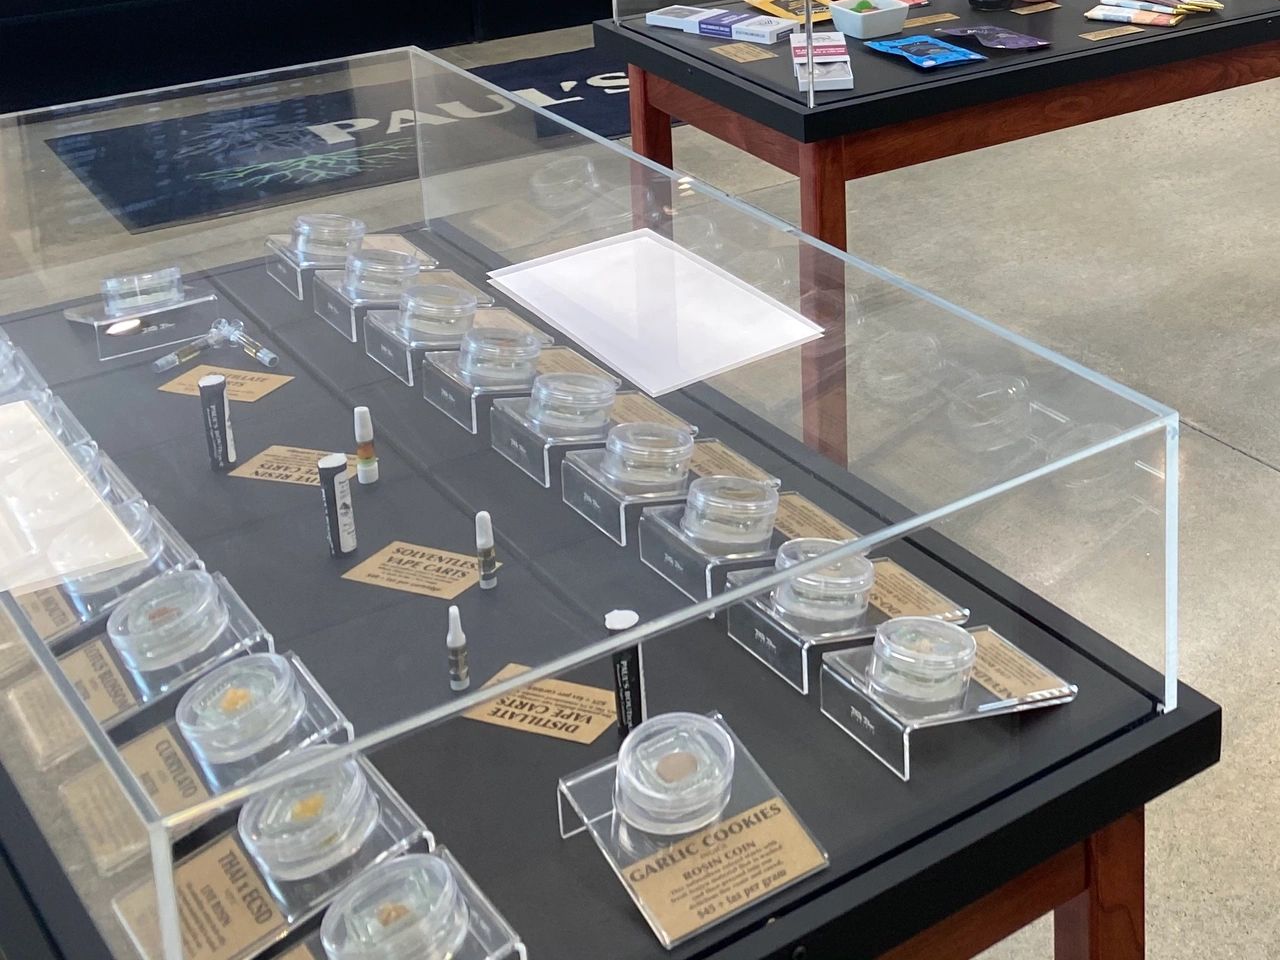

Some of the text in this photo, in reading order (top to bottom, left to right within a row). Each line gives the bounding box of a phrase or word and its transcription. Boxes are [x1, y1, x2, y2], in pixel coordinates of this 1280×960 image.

[312, 71, 631, 145] PAUL'S
[386, 555, 470, 578] VAPE CARTS
[487, 707, 580, 735] DISTILLATE
[495, 696, 594, 726] VAPE CARTS
[629, 803, 782, 885] GARLIC COOKIES
[683, 840, 756, 880] ROSIN COIN
[217, 850, 244, 883] THAI
[241, 887, 273, 925] ECSD
[726, 890, 744, 904] tax
[744, 882, 762, 898] per
[762, 869, 788, 887] gram
